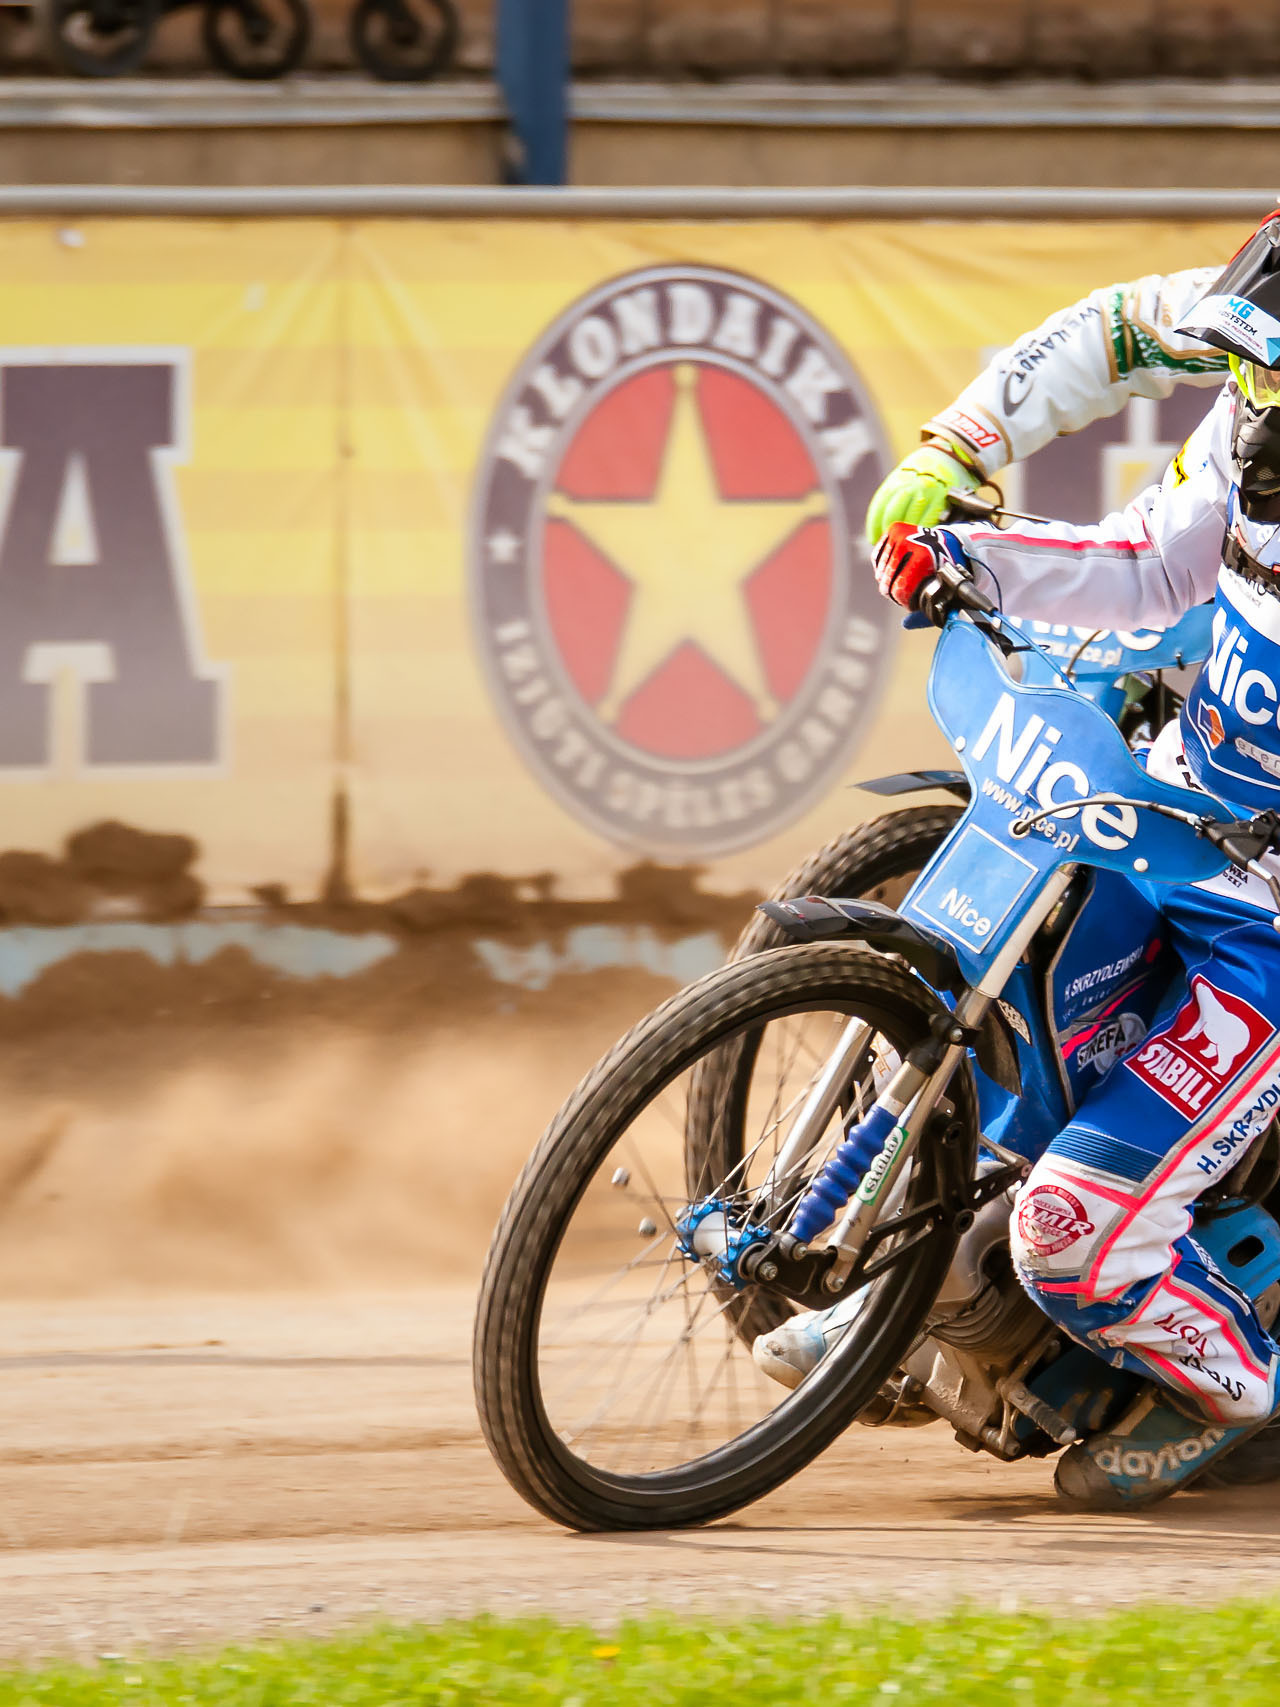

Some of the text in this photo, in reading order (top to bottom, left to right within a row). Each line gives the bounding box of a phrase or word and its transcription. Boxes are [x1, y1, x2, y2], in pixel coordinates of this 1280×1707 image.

[495, 281, 878, 482] KLONDAIKA
[971, 692, 1139, 851] Nice
[938, 887, 992, 937] Nice
[1136, 1043, 1214, 1111] STABILL
[1094, 1427, 1226, 1480] dayton
